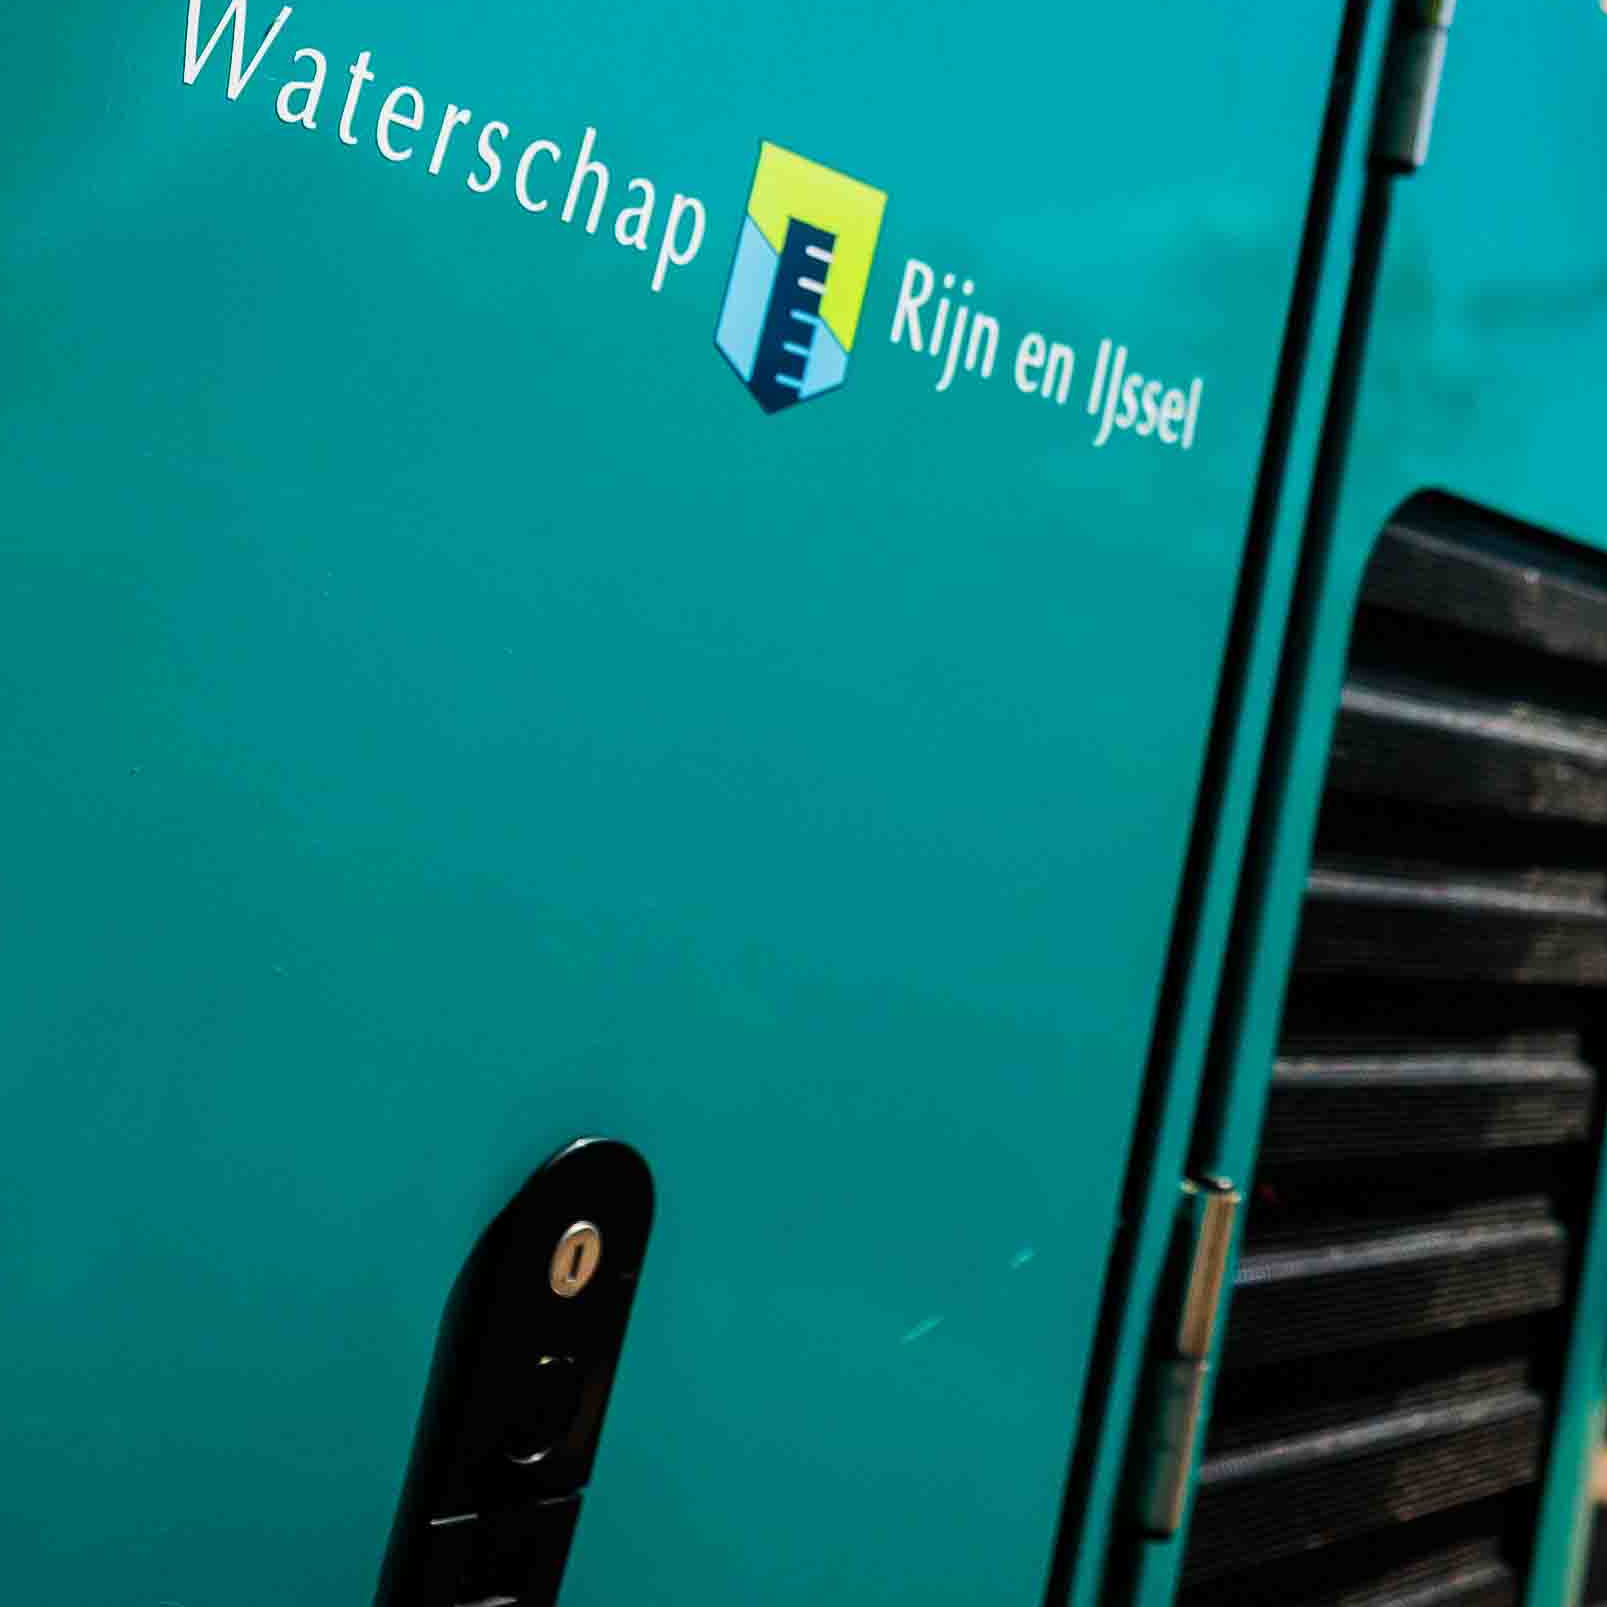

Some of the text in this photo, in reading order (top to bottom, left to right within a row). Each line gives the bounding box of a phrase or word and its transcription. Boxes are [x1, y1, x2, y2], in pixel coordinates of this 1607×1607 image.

[889, 258, 1000, 392] Rijn
[1014, 332, 1075, 405] en
[1086, 338, 1204, 450] IJssel
